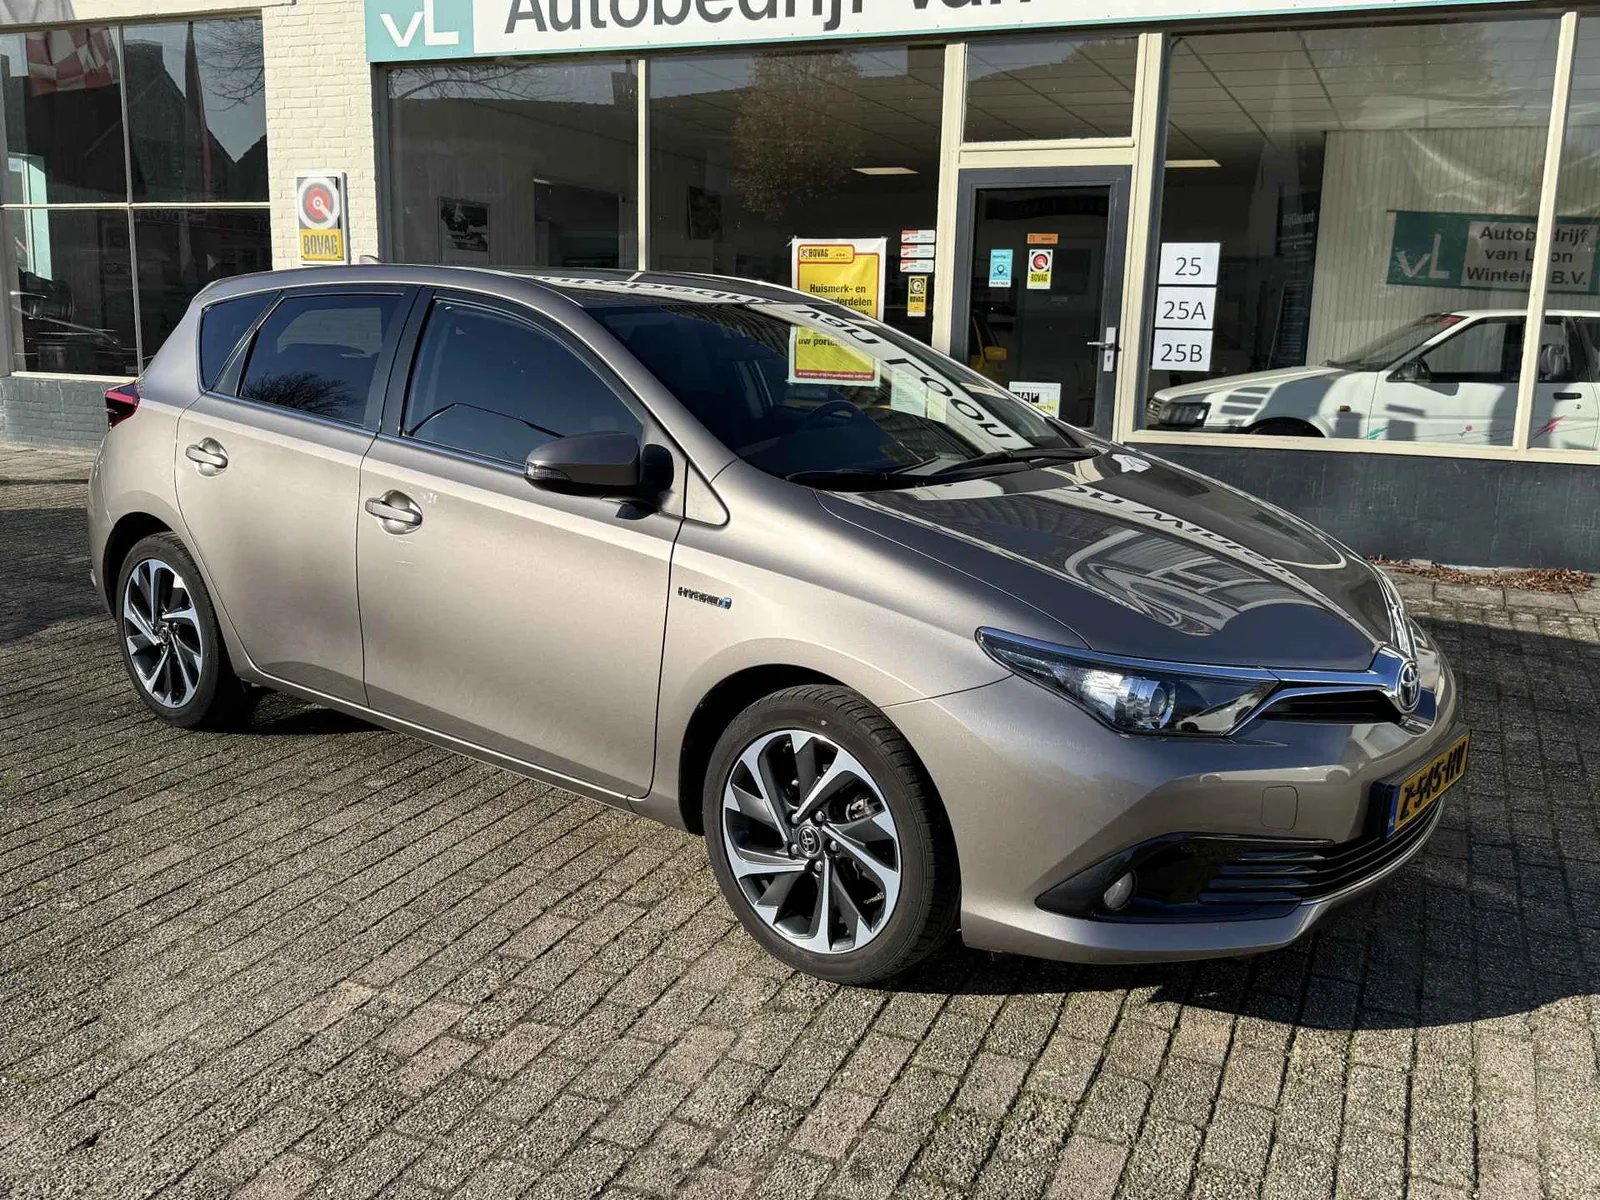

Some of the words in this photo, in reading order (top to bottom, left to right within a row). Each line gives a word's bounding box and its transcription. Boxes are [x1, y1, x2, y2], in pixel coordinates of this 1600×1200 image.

[303, 234, 338, 255] BOVAG
[1480, 226, 1588, 245] Autobdrijf
[808, 248, 829, 257] BOVAG
[1485, 249, 1518, 260] van
[1525, 248, 1573, 263] Lon
[1175, 257, 1202, 276] 25
[1030, 273, 1048, 282] BOVAG
[1467, 267, 1532, 283] Wintelr
[1551, 271, 1587, 285] B.V.
[810, 284, 853, 293] Huismerk-
[831, 297, 872, 306] derdelen
[1163, 301, 1206, 320] 25A
[1161, 343, 1203, 363] 25B
